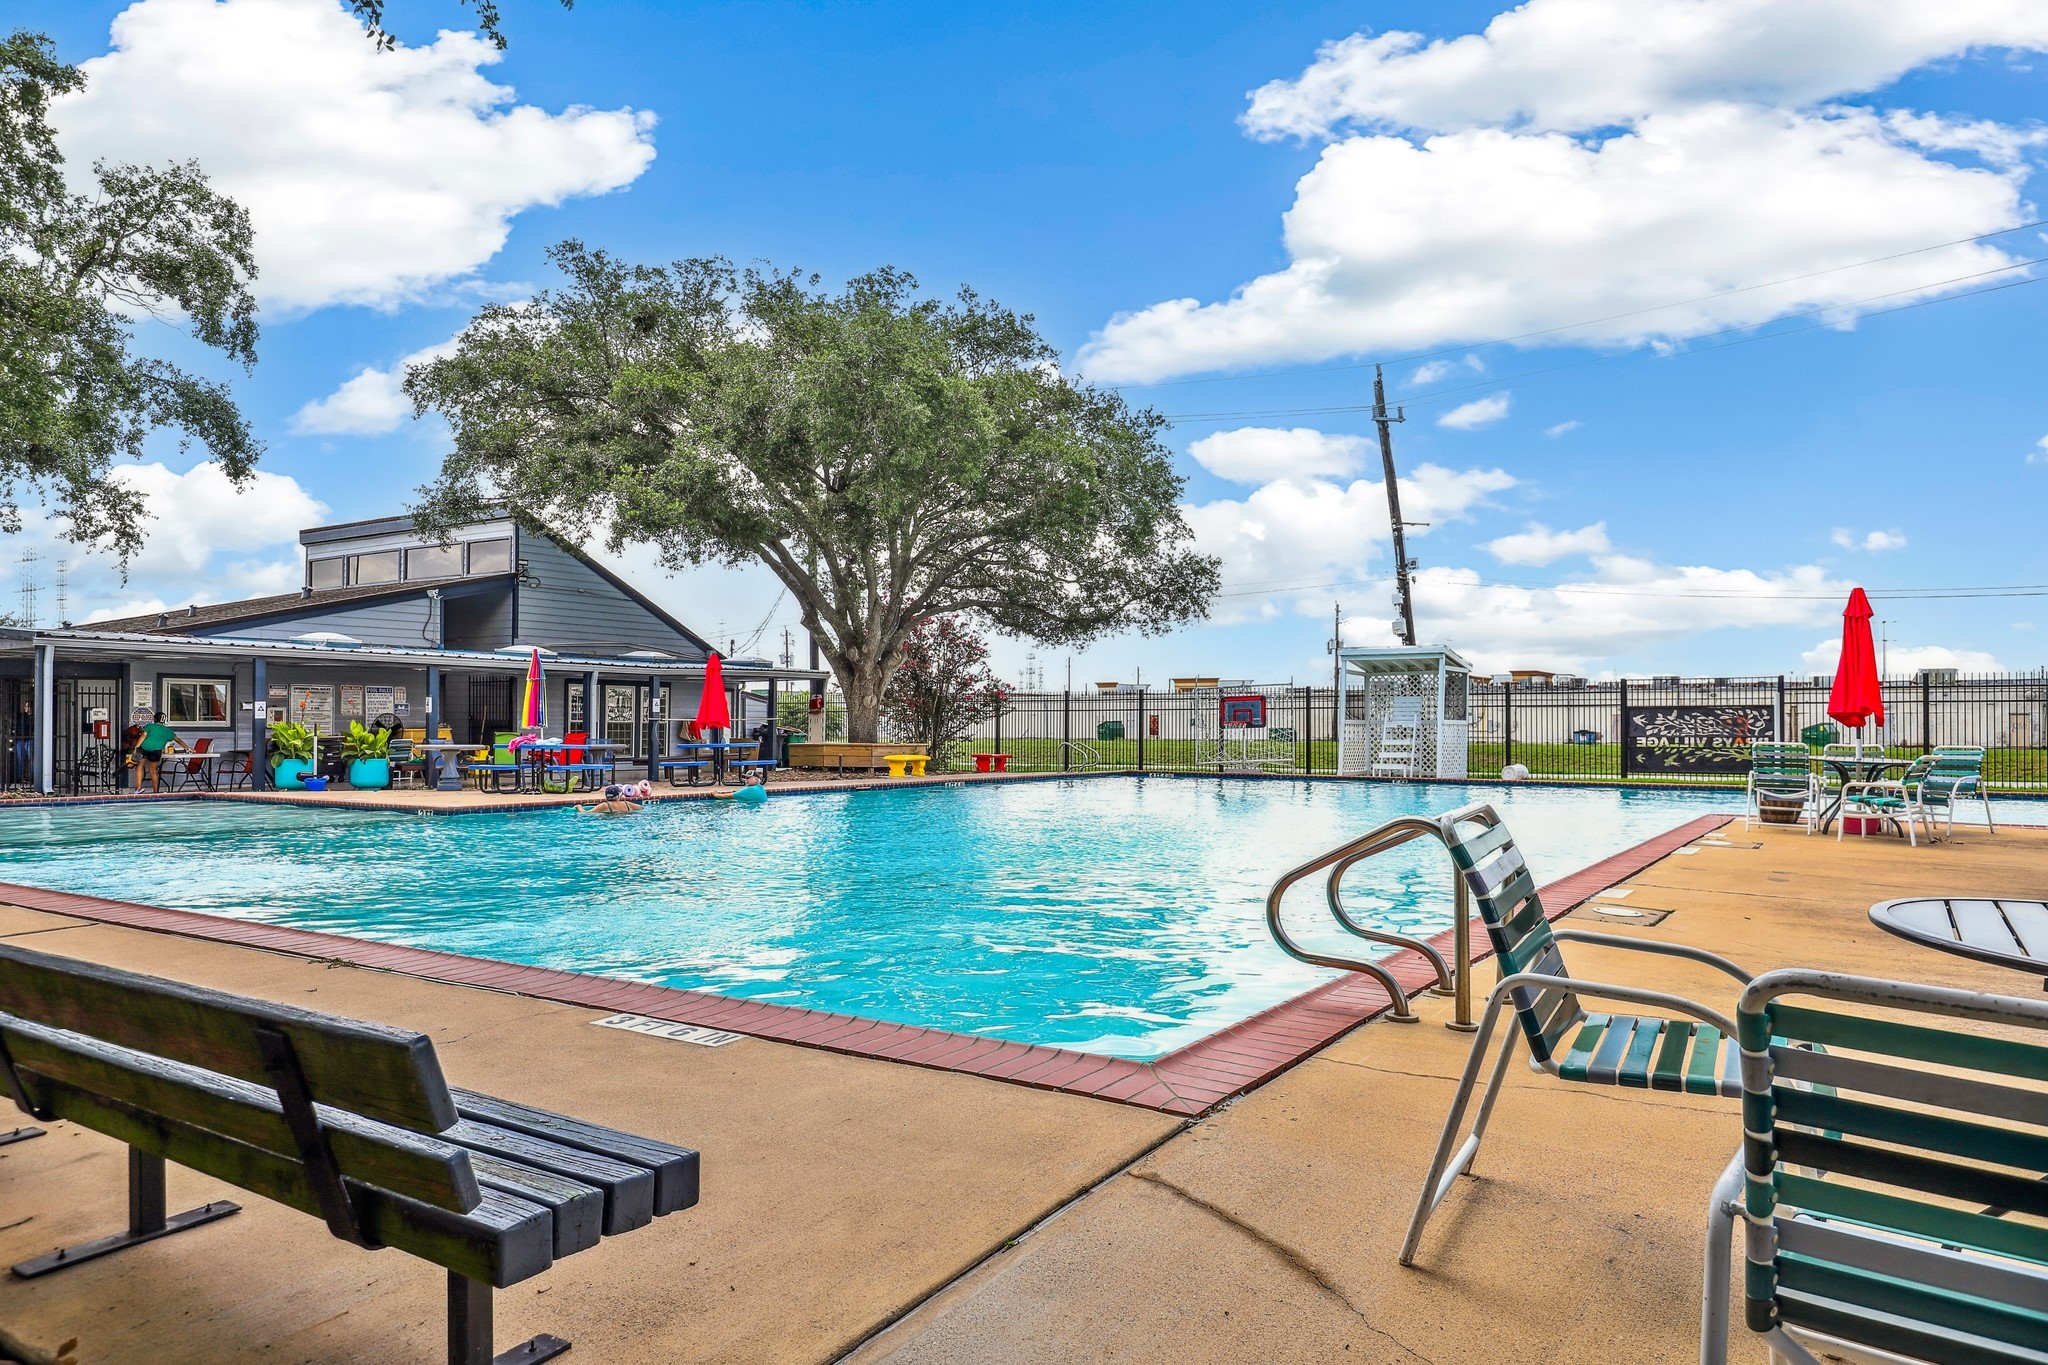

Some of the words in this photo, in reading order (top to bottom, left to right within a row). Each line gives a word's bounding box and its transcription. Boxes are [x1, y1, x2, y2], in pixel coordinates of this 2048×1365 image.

[605, 1016, 636, 1025] 3
[629, 1020, 675, 1031] FT
[667, 1027, 698, 1037] 6
[694, 1032, 738, 1044] IN
